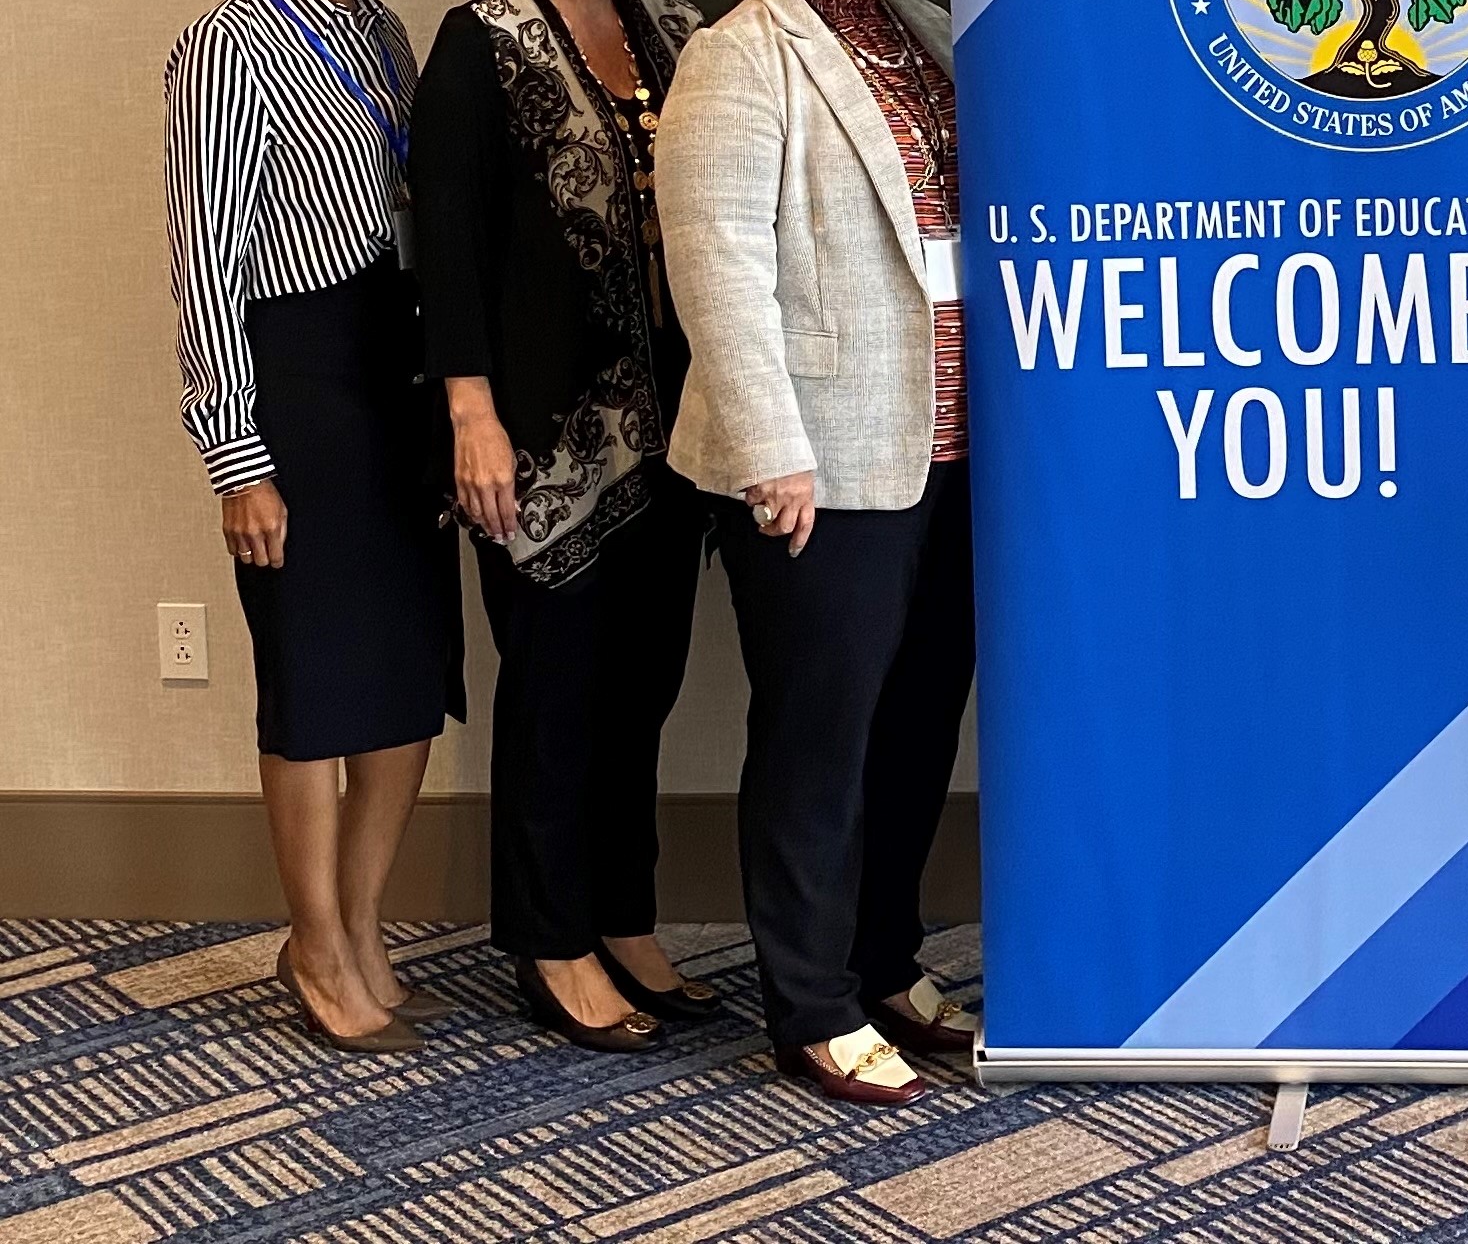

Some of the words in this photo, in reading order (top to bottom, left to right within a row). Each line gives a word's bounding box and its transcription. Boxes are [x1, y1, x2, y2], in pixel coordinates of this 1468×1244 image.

[1208, 32, 1291, 113] UNITED
[1292, 101, 1394, 137] STATES
[1399, 102, 1433, 132] OF
[988, 205, 1018, 244] U.
[1029, 204, 1057, 243] S.
[1070, 199, 1286, 243] DEPARTMENT
[1299, 198, 1342, 238] OF
[1155, 386, 1398, 500] YOU!
